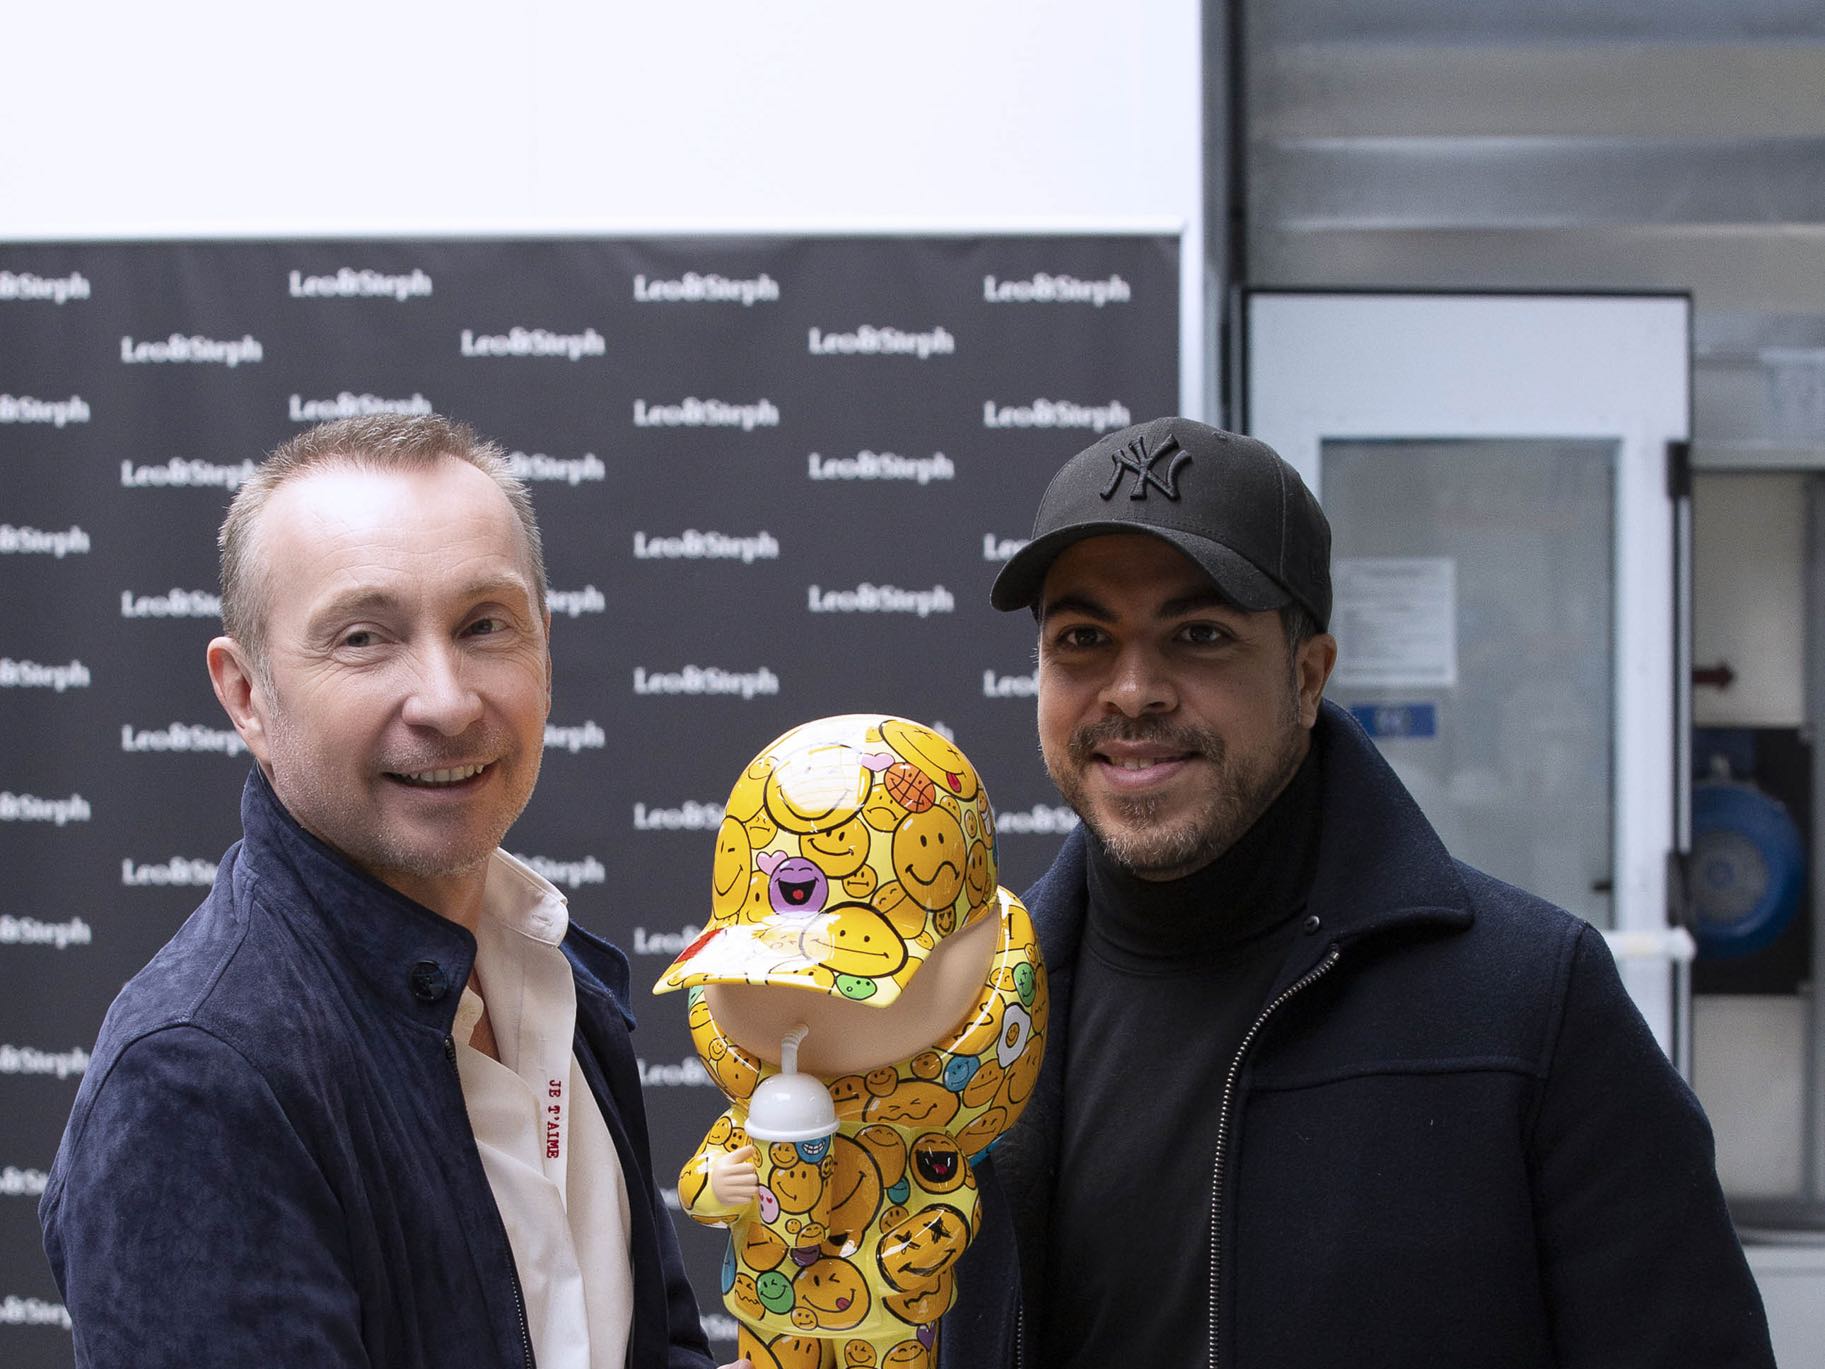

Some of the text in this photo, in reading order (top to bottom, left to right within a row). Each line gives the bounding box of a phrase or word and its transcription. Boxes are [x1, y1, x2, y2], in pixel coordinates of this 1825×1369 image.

[289, 266, 432, 301] Leo&Steph
[633, 272, 779, 306] Leo&Steph
[983, 272, 1130, 307] Leo&Steph
[120, 333, 263, 368] Leo&Steph
[460, 326, 605, 361] Leo&Steph
[808, 324, 954, 359] Leo&Steph
[633, 396, 779, 431] Leo&Steph
[983, 397, 1130, 432] Leo&Steph
[808, 449, 954, 484] Leo&Steph
[1100, 433, 1193, 501] NY
[633, 528, 779, 563] Leo&Steph
[808, 582, 954, 617] Leo&Steph
[633, 664, 779, 699] Leo&Steph
[546, 1079, 562, 1159] JE T'AIME
